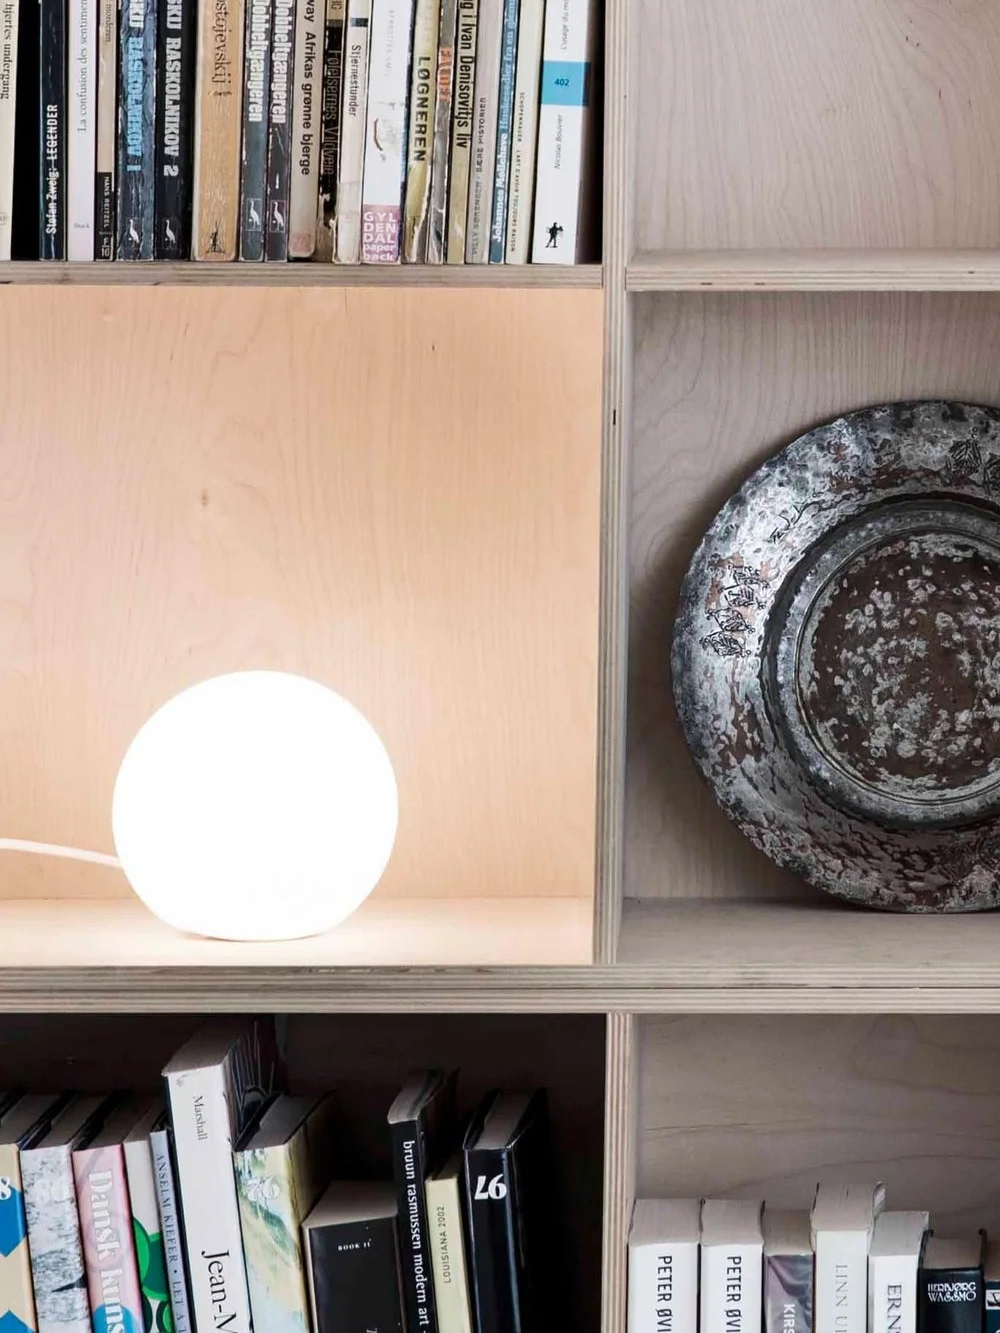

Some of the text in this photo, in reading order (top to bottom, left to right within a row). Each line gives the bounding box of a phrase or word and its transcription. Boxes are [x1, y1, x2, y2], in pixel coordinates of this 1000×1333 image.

[2, 0, 15, 41] hjertes
[105, 3, 114, 43] morderen
[460, 23, 475, 49] Ivan
[0, 44, 13, 99] undergang
[77, 45, 87, 64] des
[304, 32, 317, 78] Afrikas
[77, 66, 87, 117] confusion
[164, 37, 182, 157] RASKOLNIKOV
[348, 45, 362, 116] Stjernestunder
[455, 55, 474, 128] Denisovitjs
[554, 78, 570, 87] 402
[78, 119, 87, 132] La
[301, 84, 313, 128] grønne
[414, 57, 430, 161] LØGNEREN
[47, 104, 58, 160] LEGENDER
[456, 135, 472, 148] liv
[164, 164, 179, 177] 2
[299, 137, 314, 175] bjerge
[46, 202, 57, 234] Stefan
[364, 212, 397, 222] GYL
[364, 223, 397, 232] DEN
[493, 190, 505, 243] Johannes
[363, 234, 396, 243] DAL
[363, 244, 397, 253] paper
[363, 252, 396, 261] back
[193, 1095, 208, 1141] Marshall
[88, 1170, 121, 1260] Dansk
[155, 1153, 172, 1208] ANSELM
[164, 1214, 178, 1263] KIEFER
[337, 1242, 360, 1251] BOOK
[403, 1140, 430, 1326] bruun rasmussen modern art
[436, 1206, 451, 1284] LOUISIANA 2002
[657, 1256, 673, 1302] PETER
[726, 1256, 742, 1303] PETER
[835, 1265, 848, 1308] LINN
[927, 1291, 977, 1303] WASSMO
